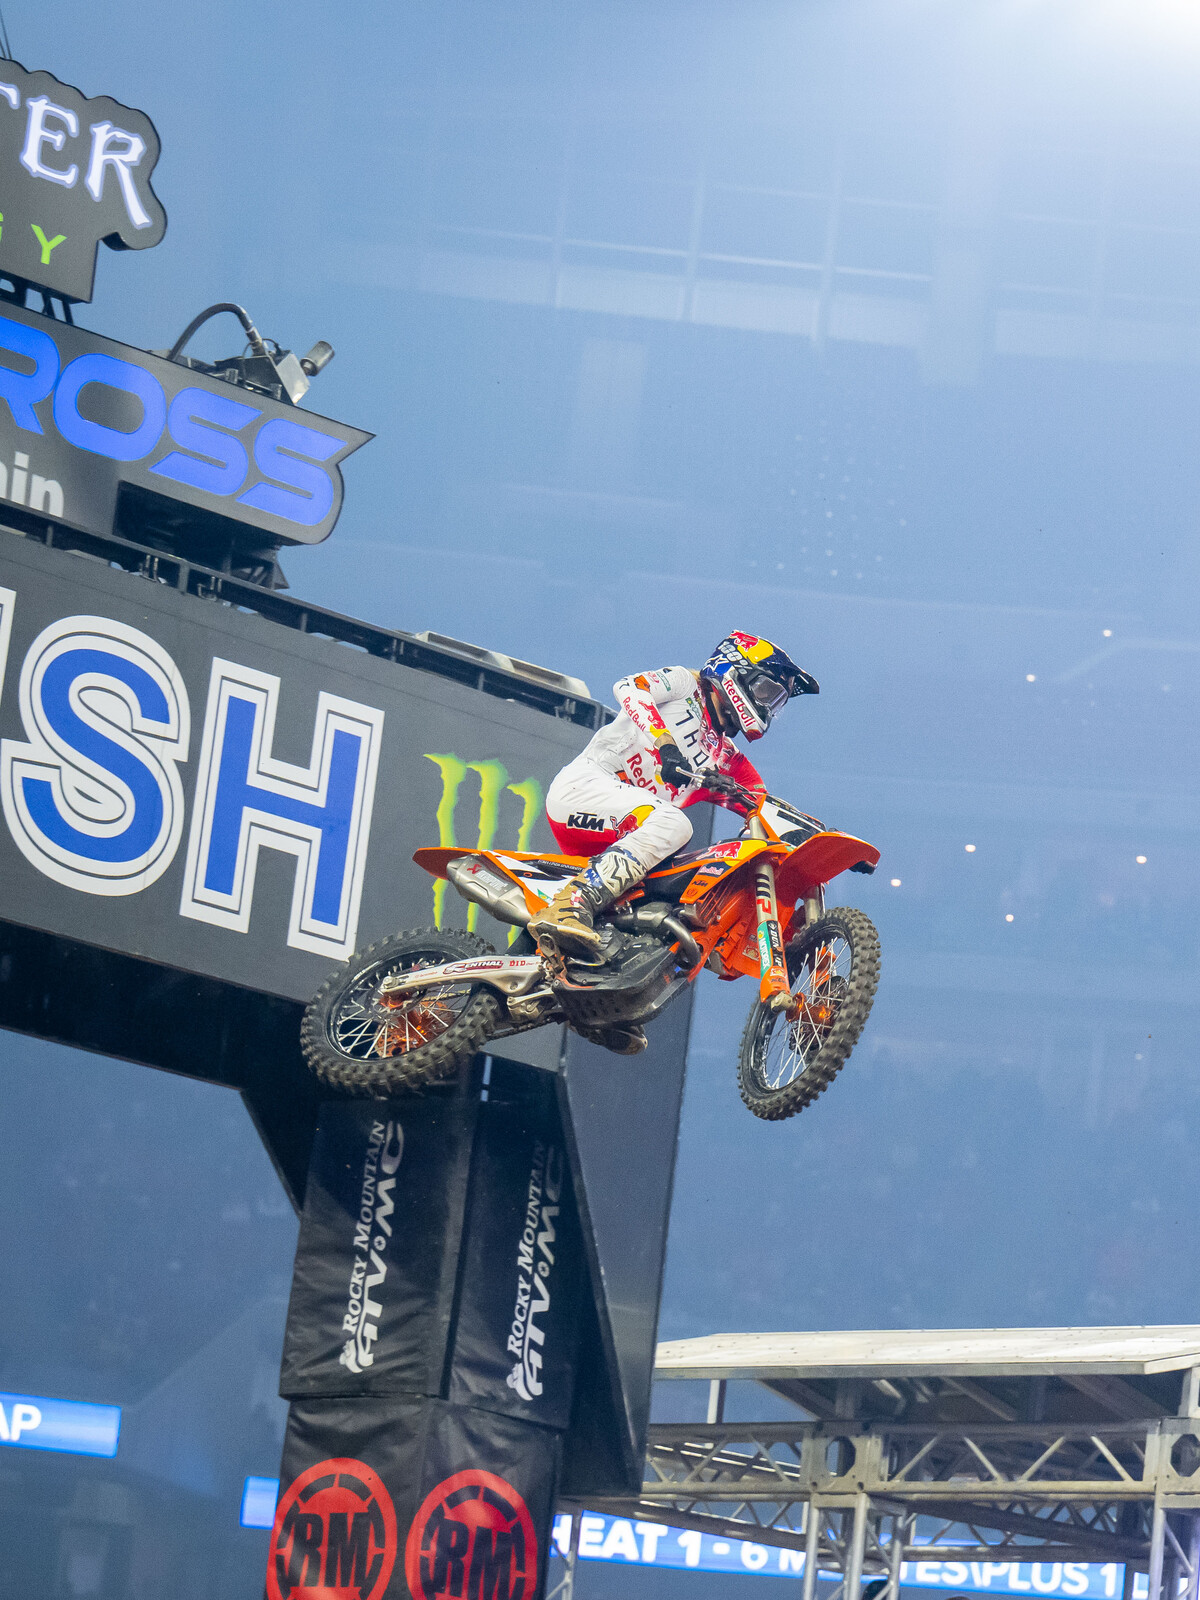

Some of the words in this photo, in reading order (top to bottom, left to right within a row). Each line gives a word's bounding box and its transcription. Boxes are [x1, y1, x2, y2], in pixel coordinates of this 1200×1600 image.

[0, 82, 152, 229] ER
[0, 452, 65, 518] in
[0, 587, 386, 961] SH
[567, 812, 605, 832] KTM
[442, 960, 504, 975] RENTHAL
[353, 1120, 386, 1252] MOUNTAIN
[517, 1141, 546, 1275] MOUNTAIN
[342, 1255, 368, 1335] ROCKY
[507, 1274, 533, 1358] ROCKY
[552, 1513, 668, 1563] HEAT
[677, 1529, 702, 1568] 1
